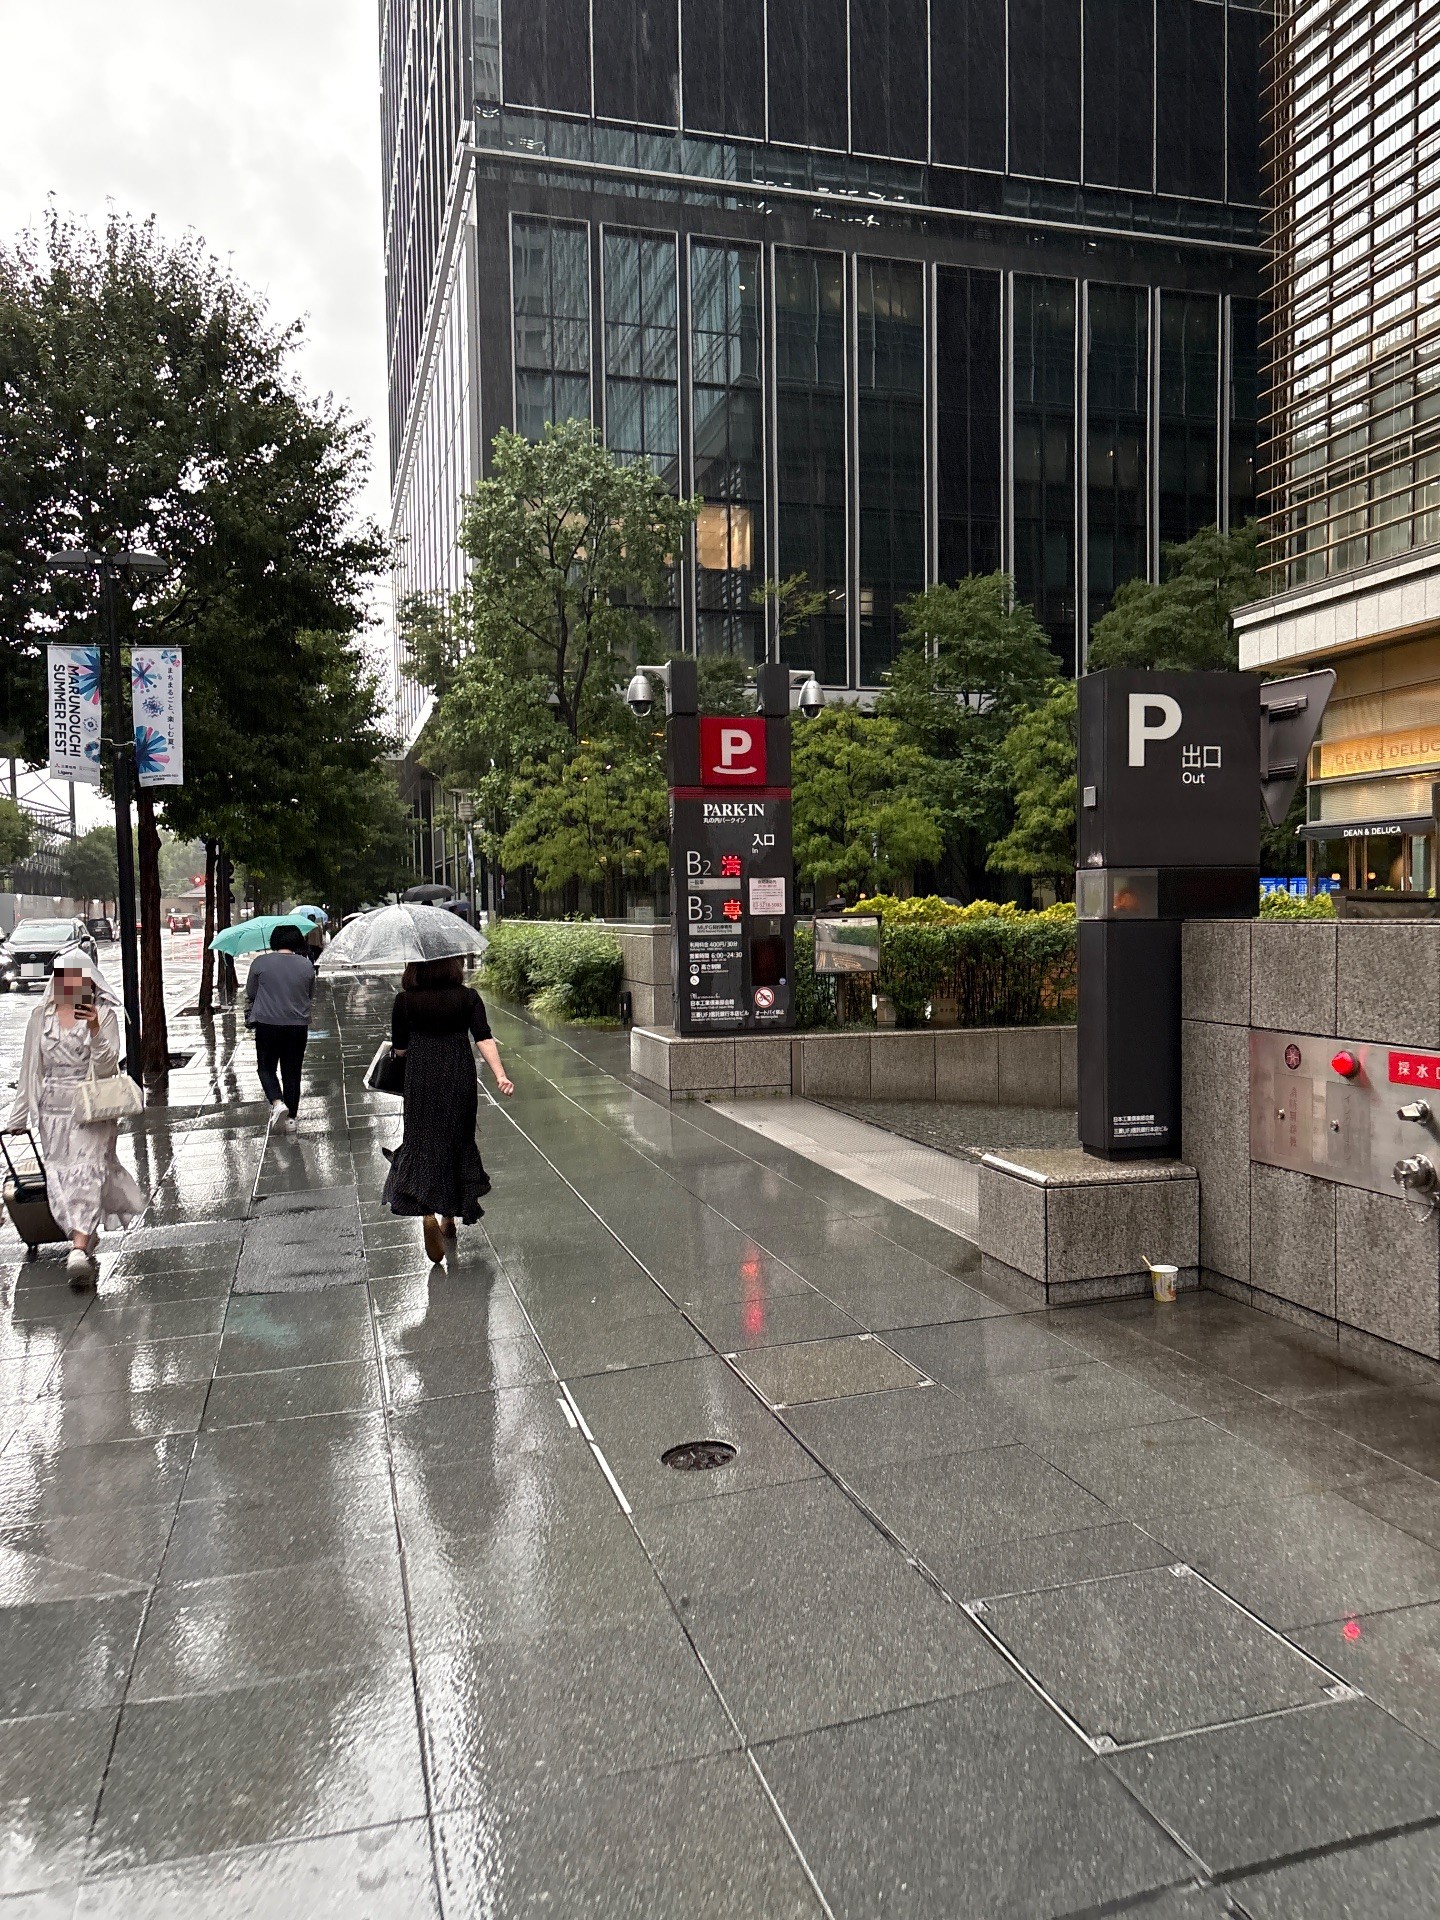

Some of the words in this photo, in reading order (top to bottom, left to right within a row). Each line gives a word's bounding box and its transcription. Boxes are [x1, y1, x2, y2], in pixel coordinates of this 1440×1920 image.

[54, 664, 66, 719] SUMMER
[67, 665, 81, 757] MARUNOUCHI
[167, 667, 175, 749] まちまるごと、楽しむ夏。
[55, 723, 67, 756] FEST
[1128, 693, 1183, 767] P
[721, 729, 752, 766] P
[1181, 743, 1222, 768] 出口
[1335, 749, 1373, 766] DEAN
[1182, 771, 1206, 784] Out
[703, 803, 765, 816] PARK-IN
[752, 833, 775, 846] 入口
[1343, 829, 1363, 837] DEAN
[1364, 828, 1370, 836] &
[1371, 825, 1401, 835] DELUCA
[687, 851, 711, 875] B2
[688, 896, 712, 920] B3
